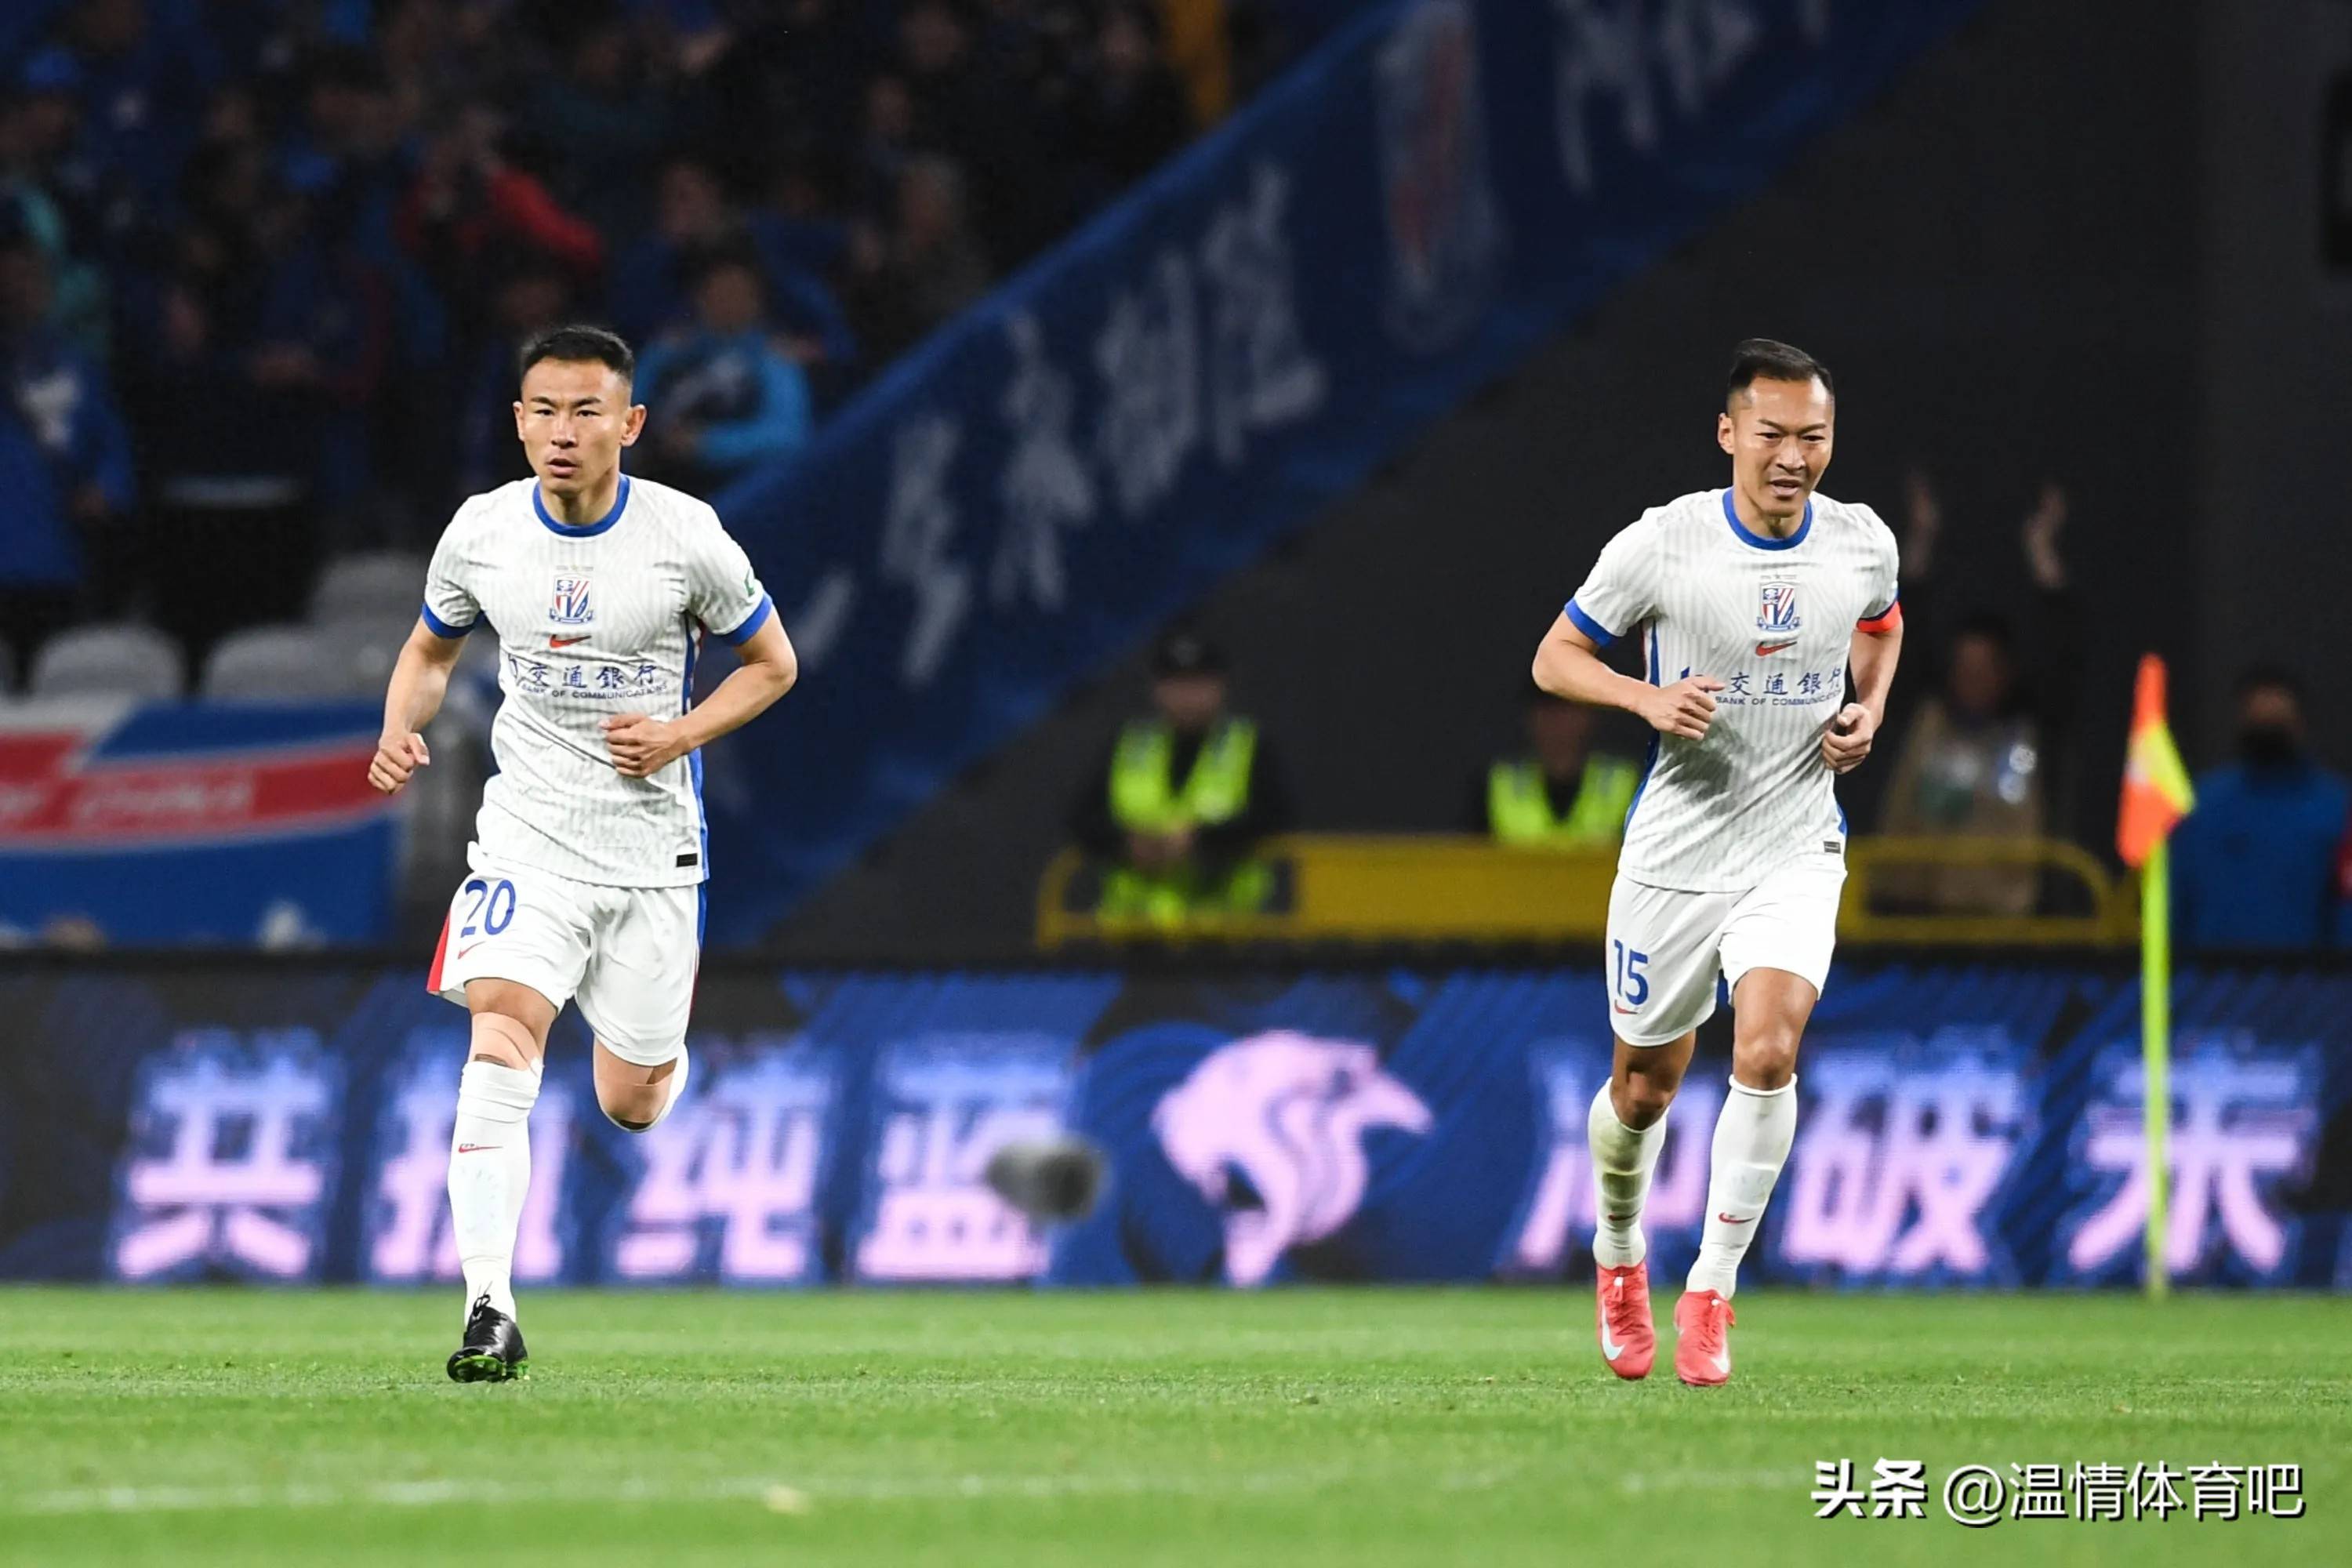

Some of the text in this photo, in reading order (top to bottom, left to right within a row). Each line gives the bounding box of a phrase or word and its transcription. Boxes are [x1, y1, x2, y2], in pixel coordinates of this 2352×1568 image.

[1715, 696, 1745, 705] BANK
[463, 879, 516, 938] 20
[1613, 939, 1649, 1006] 15
